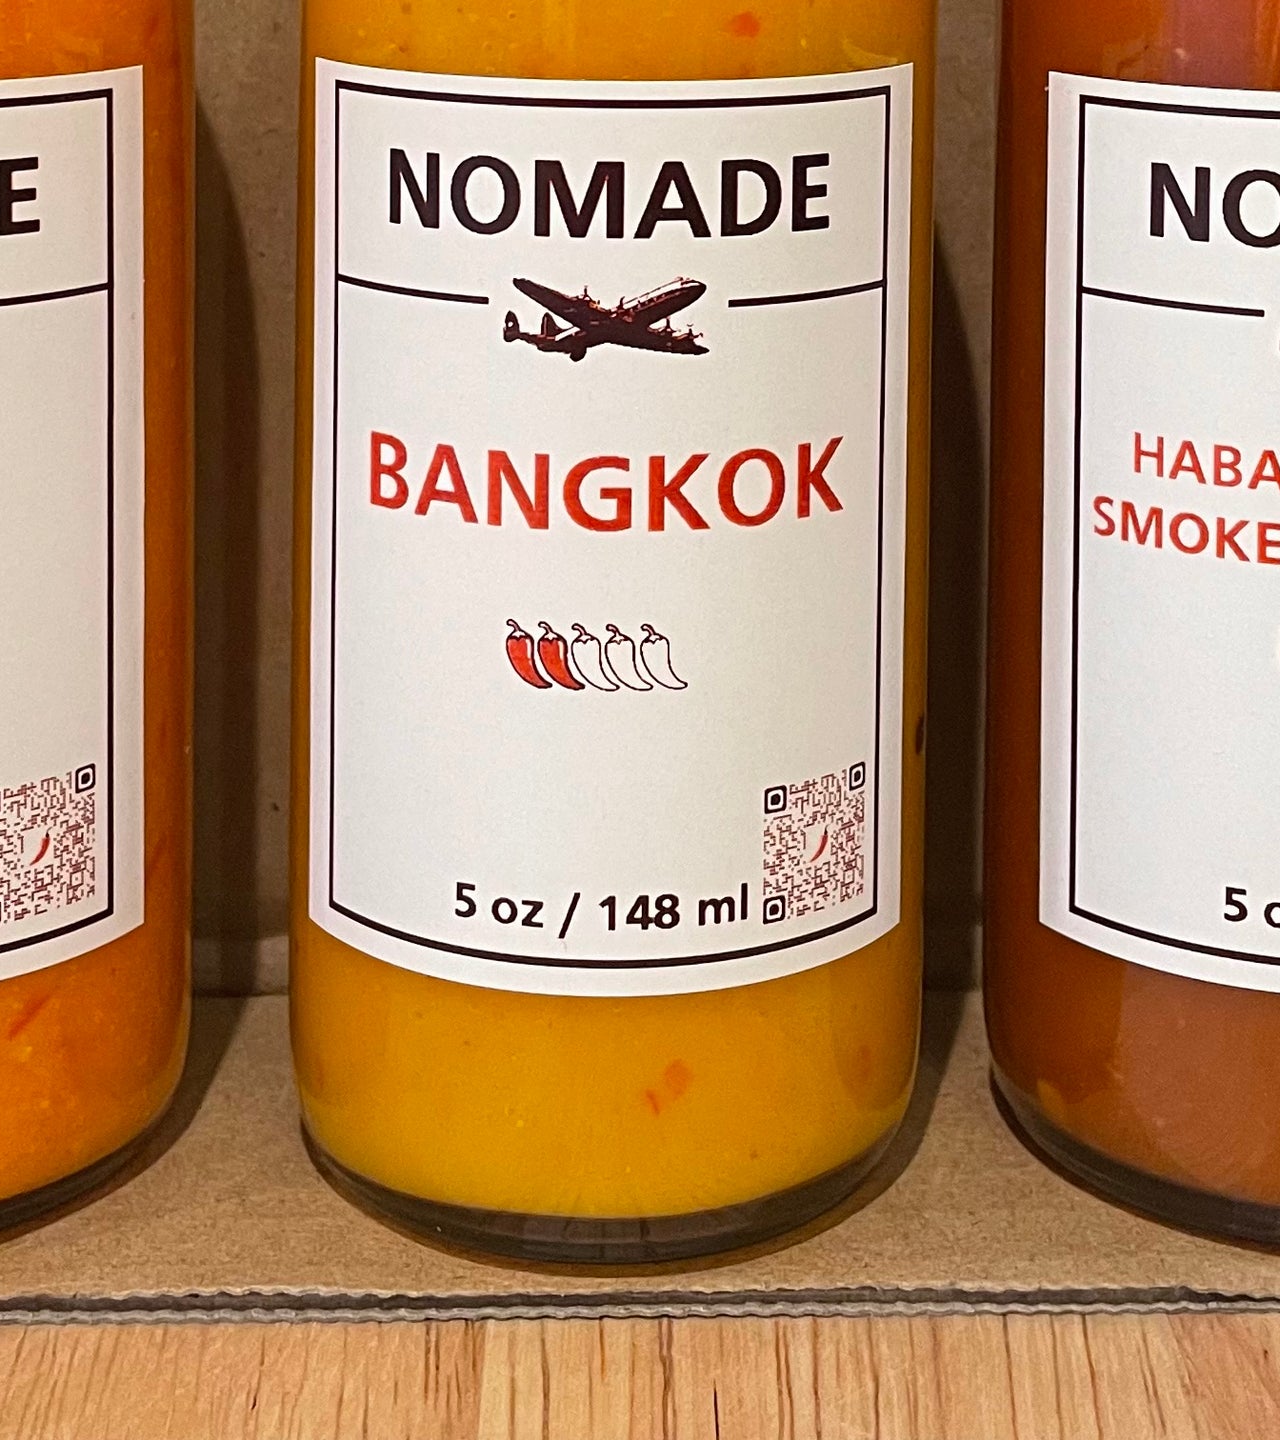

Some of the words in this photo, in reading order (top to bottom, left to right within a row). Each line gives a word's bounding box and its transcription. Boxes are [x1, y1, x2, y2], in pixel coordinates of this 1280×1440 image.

[389, 147, 830, 240] NOMADE
[370, 431, 844, 532] BANGKOK
[454, 881, 477, 918] 5
[491, 897, 544, 929] oz
[558, 892, 581, 940] /
[598, 893, 681, 931] 148
[698, 882, 748, 927] ml
[1223, 886, 1248, 923] 5
